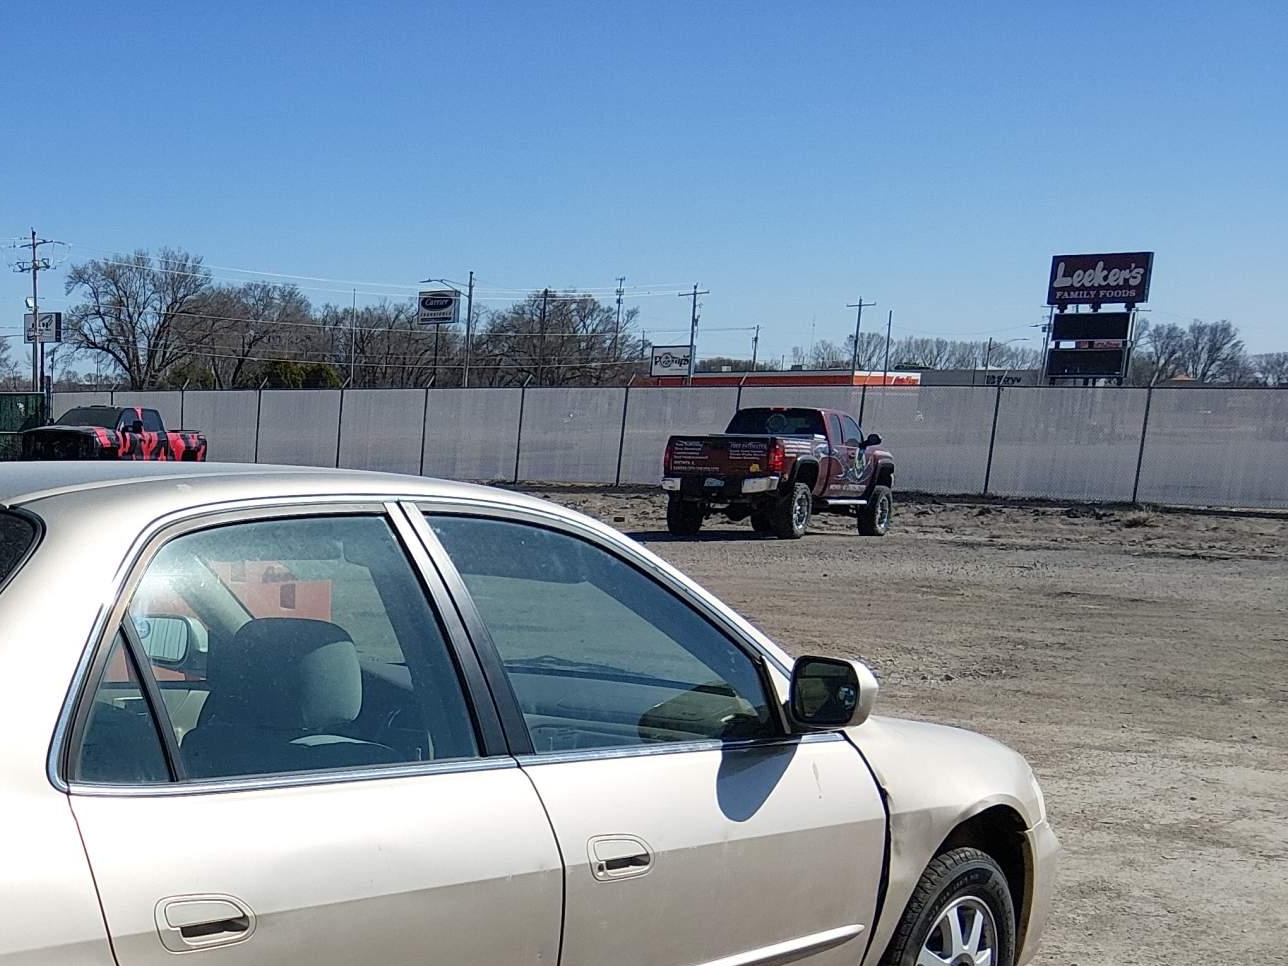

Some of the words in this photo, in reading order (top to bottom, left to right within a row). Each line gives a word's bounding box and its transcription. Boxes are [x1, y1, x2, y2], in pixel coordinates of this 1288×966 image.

[1053, 261, 1145, 288] Leeker's
[1055, 290, 1097, 299] FAMILY
[1099, 289, 1136, 298] FOODS
[424, 298, 449, 307] Carrier
